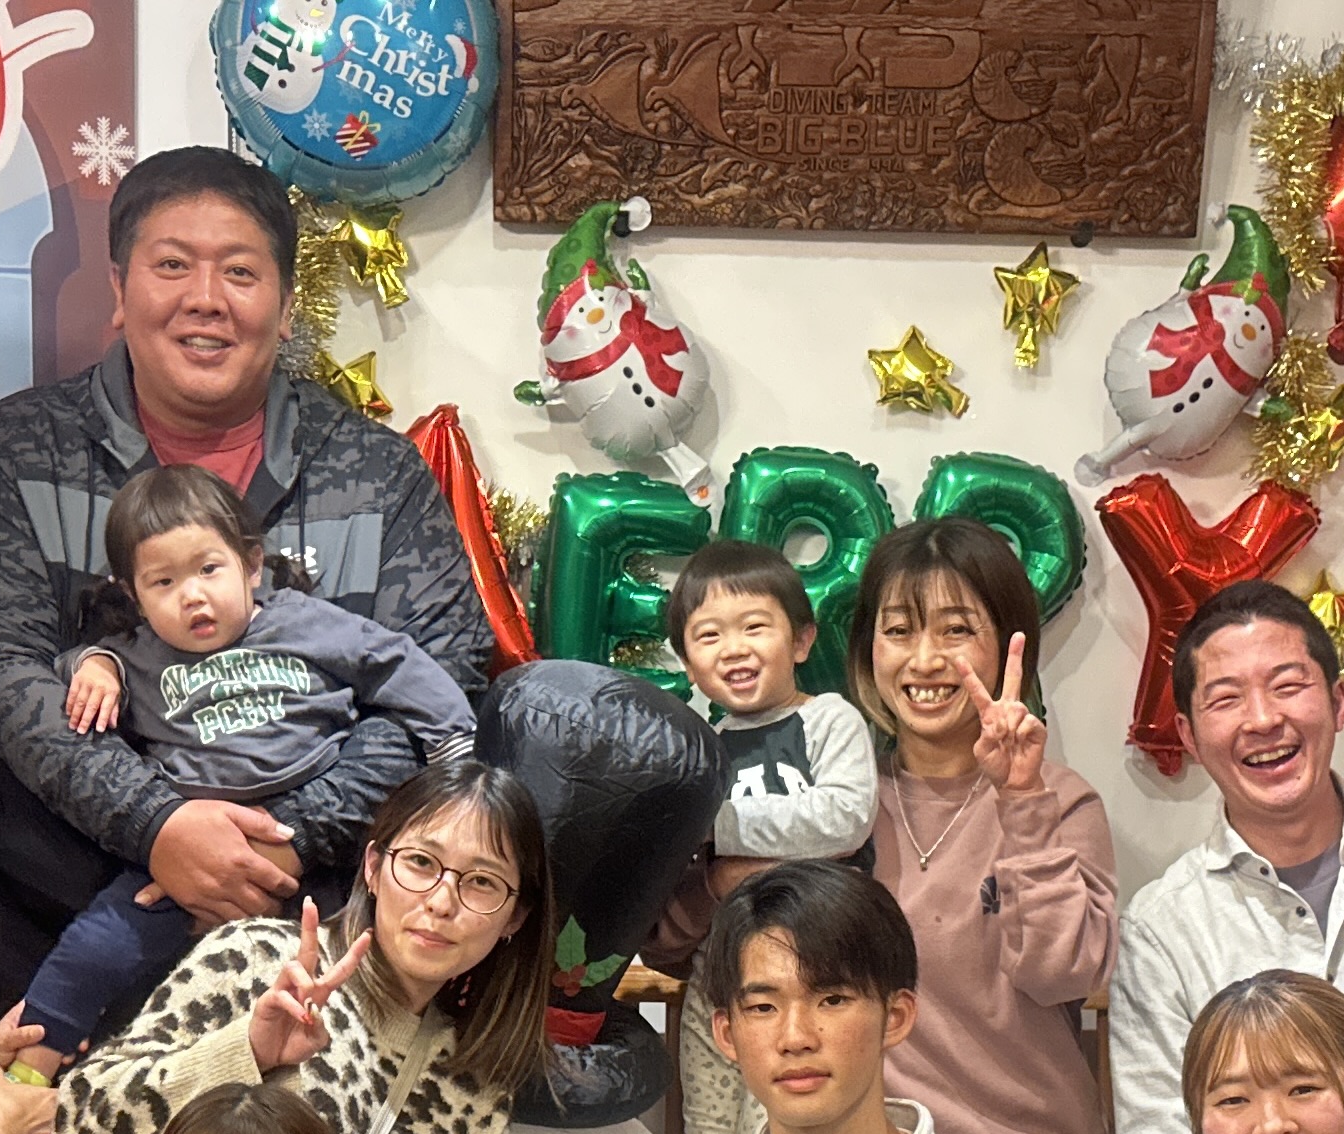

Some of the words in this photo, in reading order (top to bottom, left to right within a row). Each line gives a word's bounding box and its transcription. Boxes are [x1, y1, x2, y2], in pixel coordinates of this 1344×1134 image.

[340, 14, 454, 97] Christ
[376, 1, 449, 62] Merry
[335, 60, 414, 118] mas
[768, 89, 850, 115] DIVING
[866, 91, 937, 116] TEAM
[757, 116, 824, 155] BIG
[839, 118, 953, 156] BLUE
[799, 157, 850, 173] SINCE
